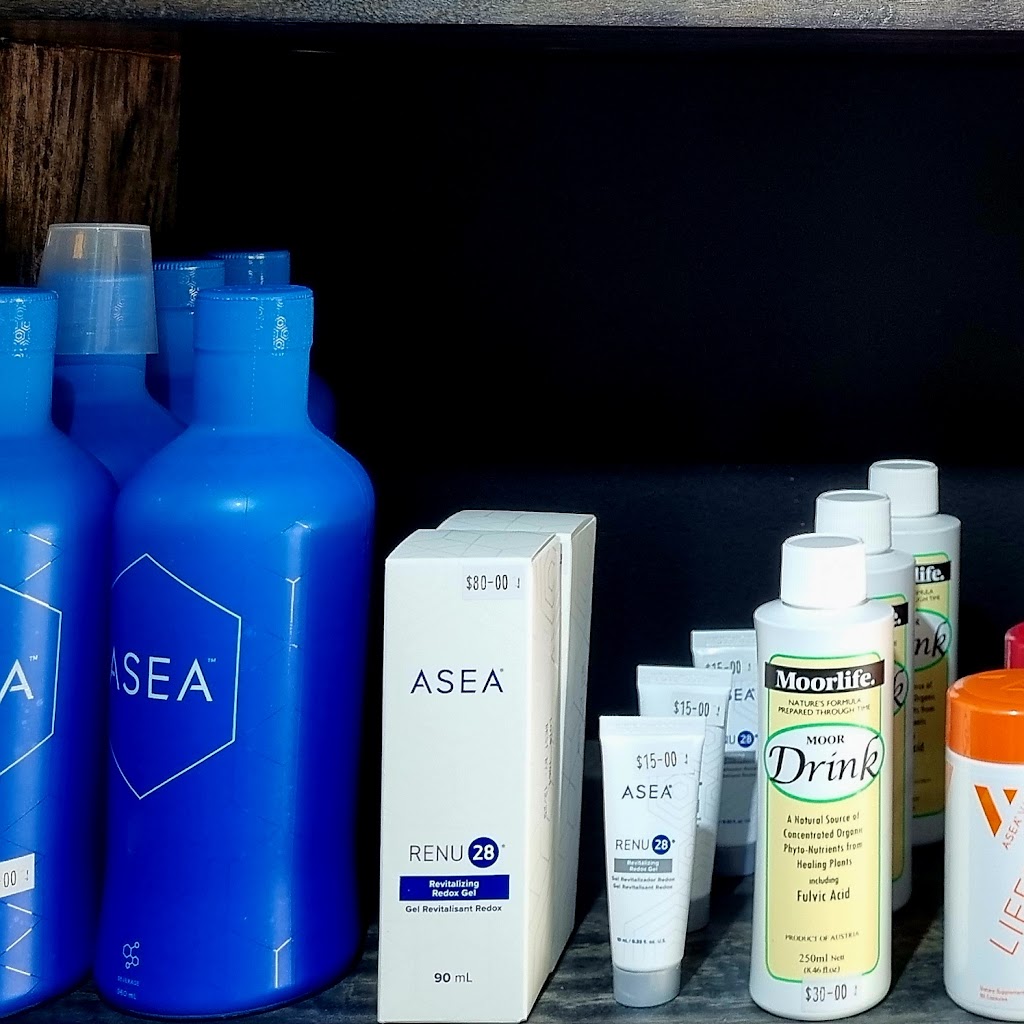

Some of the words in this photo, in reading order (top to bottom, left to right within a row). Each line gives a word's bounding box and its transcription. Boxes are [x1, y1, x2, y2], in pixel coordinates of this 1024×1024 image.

[466, 574, 509, 592] $80-00
[110, 647, 213, 703] ASEA
[411, 668, 504, 694] ASEA
[673, 699, 710, 717] $15-00
[788, 699, 825, 707] NATURE'S
[826, 698, 862, 707] FORMULA
[778, 706, 814, 716] PREPARED
[816, 707, 855, 715] THROUGH
[806, 734, 845, 745] MOOR
[636, 751, 677, 769] $15-00
[769, 734, 880, 785] Drink
[621, 784, 672, 799] ASEA
[787, 814, 793, 824] A
[794, 814, 824, 825] Natural
[825, 813, 850, 825] Source
[852, 812, 860, 821] of
[783, 828, 834, 840] Concentrated
[836, 827, 863, 840] Organic
[615, 839, 650, 851] RENU
[654, 839, 669, 850] 28
[783, 843, 844, 856] Phyto-Nutrients
[846, 841, 863, 852] from
[409, 844, 463, 862] RENU
[472, 844, 495, 861] 28
[796, 859, 827, 871] Healing
[829, 858, 852, 868] Plants
[428, 879, 480, 888] Revitalizing
[808, 875, 839, 885] including
[432, 889, 459, 897] Redox
[461, 889, 477, 897] Gel
[796, 889, 826, 902] Fulvic
[829, 887, 850, 900] Acid
[405, 905, 420, 913] Gel
[422, 905, 473, 913] Revitalisant
[475, 904, 502, 912] Redox
[785, 934, 817, 942] PRODUCT
[830, 931, 860, 940] AUSTRIA
[799, 953, 828, 963] 250ml
[434, 972, 451, 983] 90
[454, 972, 473, 983] mL
[805, 984, 847, 1002] $30-00
